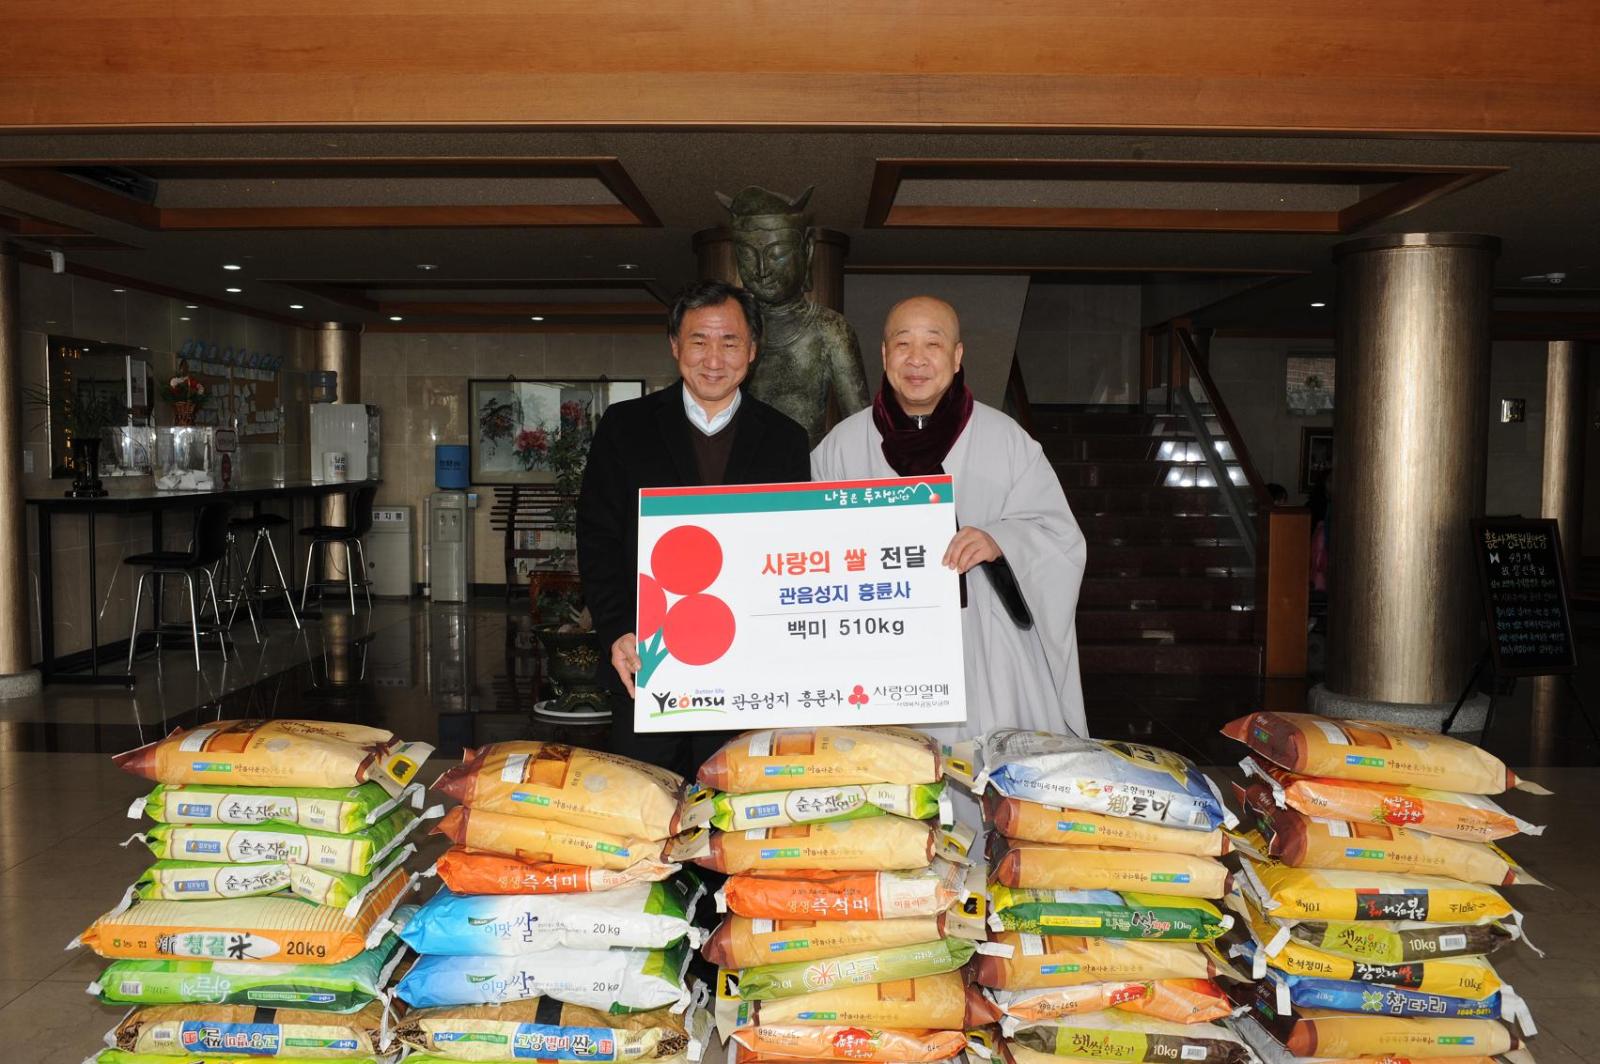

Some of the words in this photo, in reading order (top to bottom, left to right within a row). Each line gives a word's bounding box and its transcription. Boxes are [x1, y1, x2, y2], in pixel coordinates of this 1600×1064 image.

[825, 489, 858, 506] 나눔은
[761, 550, 831, 577] 사랑의
[844, 548, 868, 572] 쌀
[879, 545, 927, 570] 전달
[779, 583, 849, 606] 관음성지
[858, 581, 911, 601] 흥륜사
[787, 618, 828, 641] 백미
[839, 617, 905, 637] 510kg
[652, 690, 725, 714] Yeonsu
[731, 690, 790, 712] 관음성지
[797, 689, 844, 709] 흥륜사
[873, 683, 949, 701] 사랑의열매
[287, 940, 326, 958] 20kg
[1409, 938, 1437, 952] 10kg
[1386, 990, 1447, 1014] 참다리
[1153, 1044, 1178, 1060] 10kg
